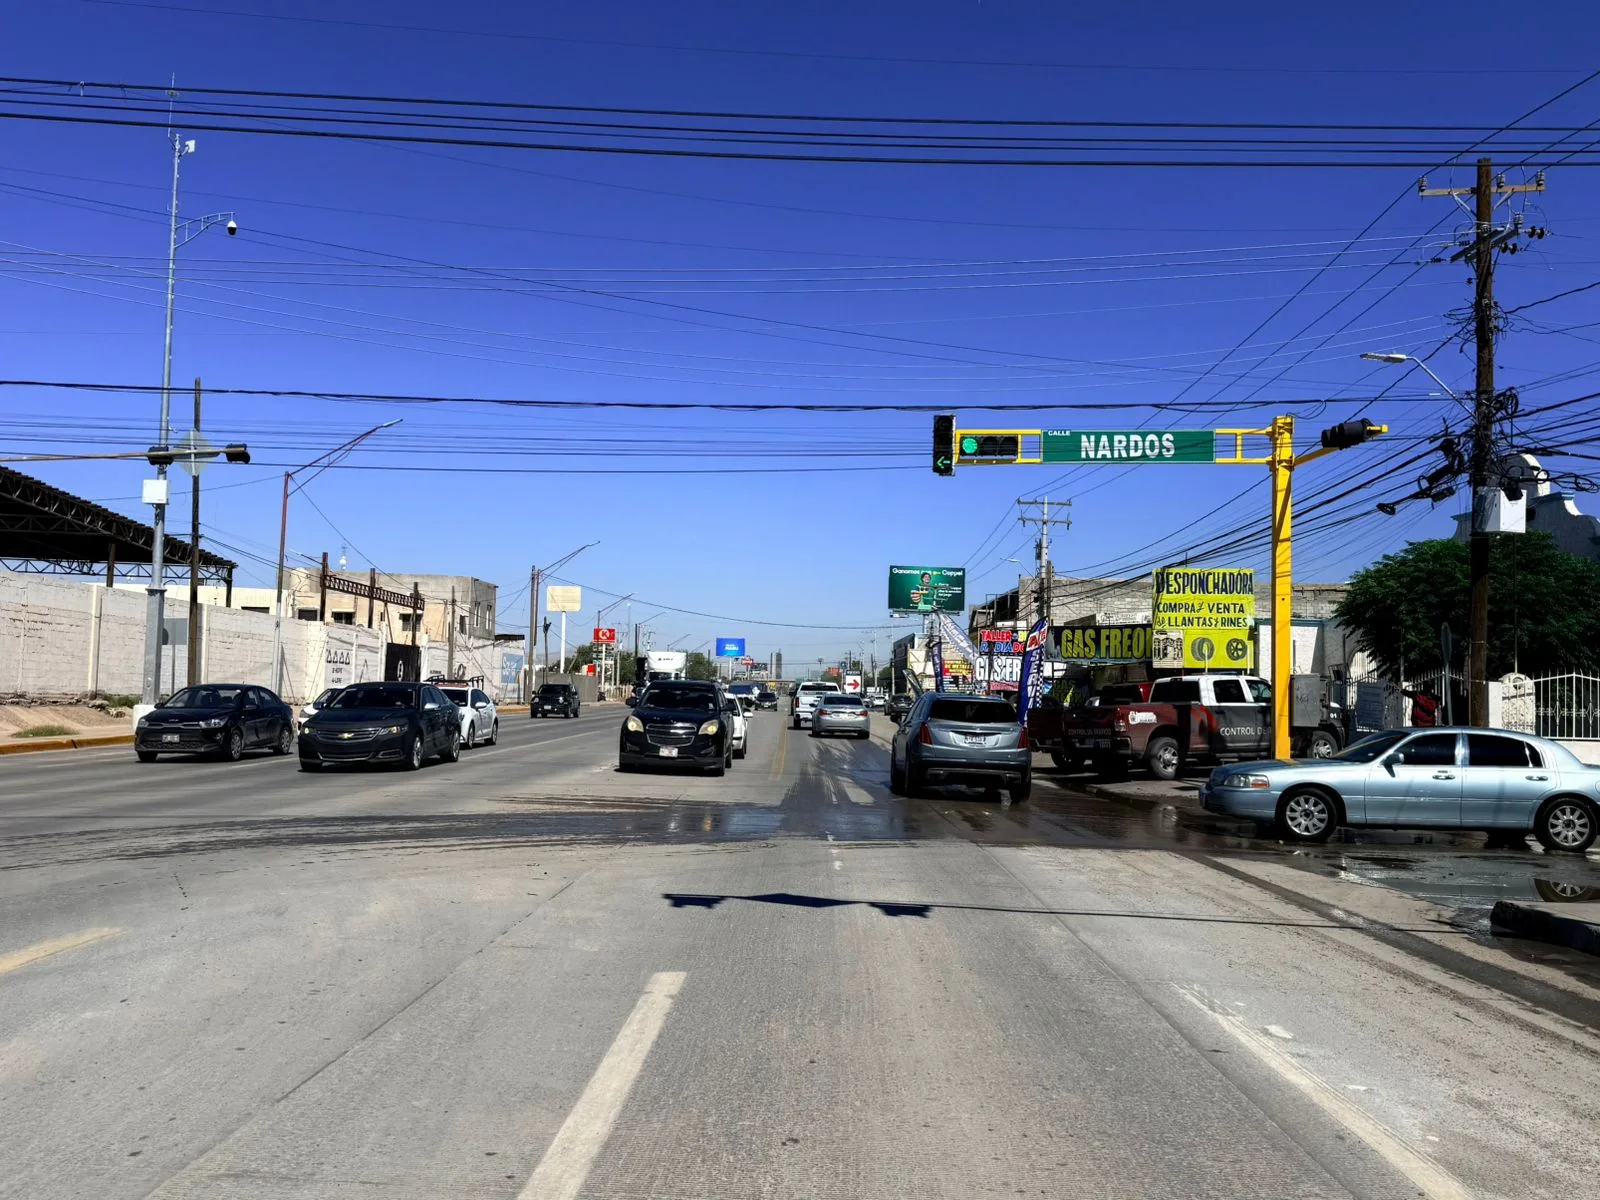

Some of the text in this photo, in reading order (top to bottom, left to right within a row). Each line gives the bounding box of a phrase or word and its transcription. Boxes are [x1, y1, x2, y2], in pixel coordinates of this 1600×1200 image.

[1081, 433, 1175, 458] NARDOS
[942, 569, 963, 577] Coppel
[1155, 572, 1254, 595] DESPONCHADORA
[1157, 602, 1196, 613] COMPRA
[1208, 602, 1245, 614] VENTA
[1168, 616, 1213, 627] LLANTAS
[1221, 617, 1248, 627] RINES
[981, 630, 1012, 641] TALLER
[1061, 628, 1096, 658] GAS
[1220, 726, 1255, 736] CONTROL
